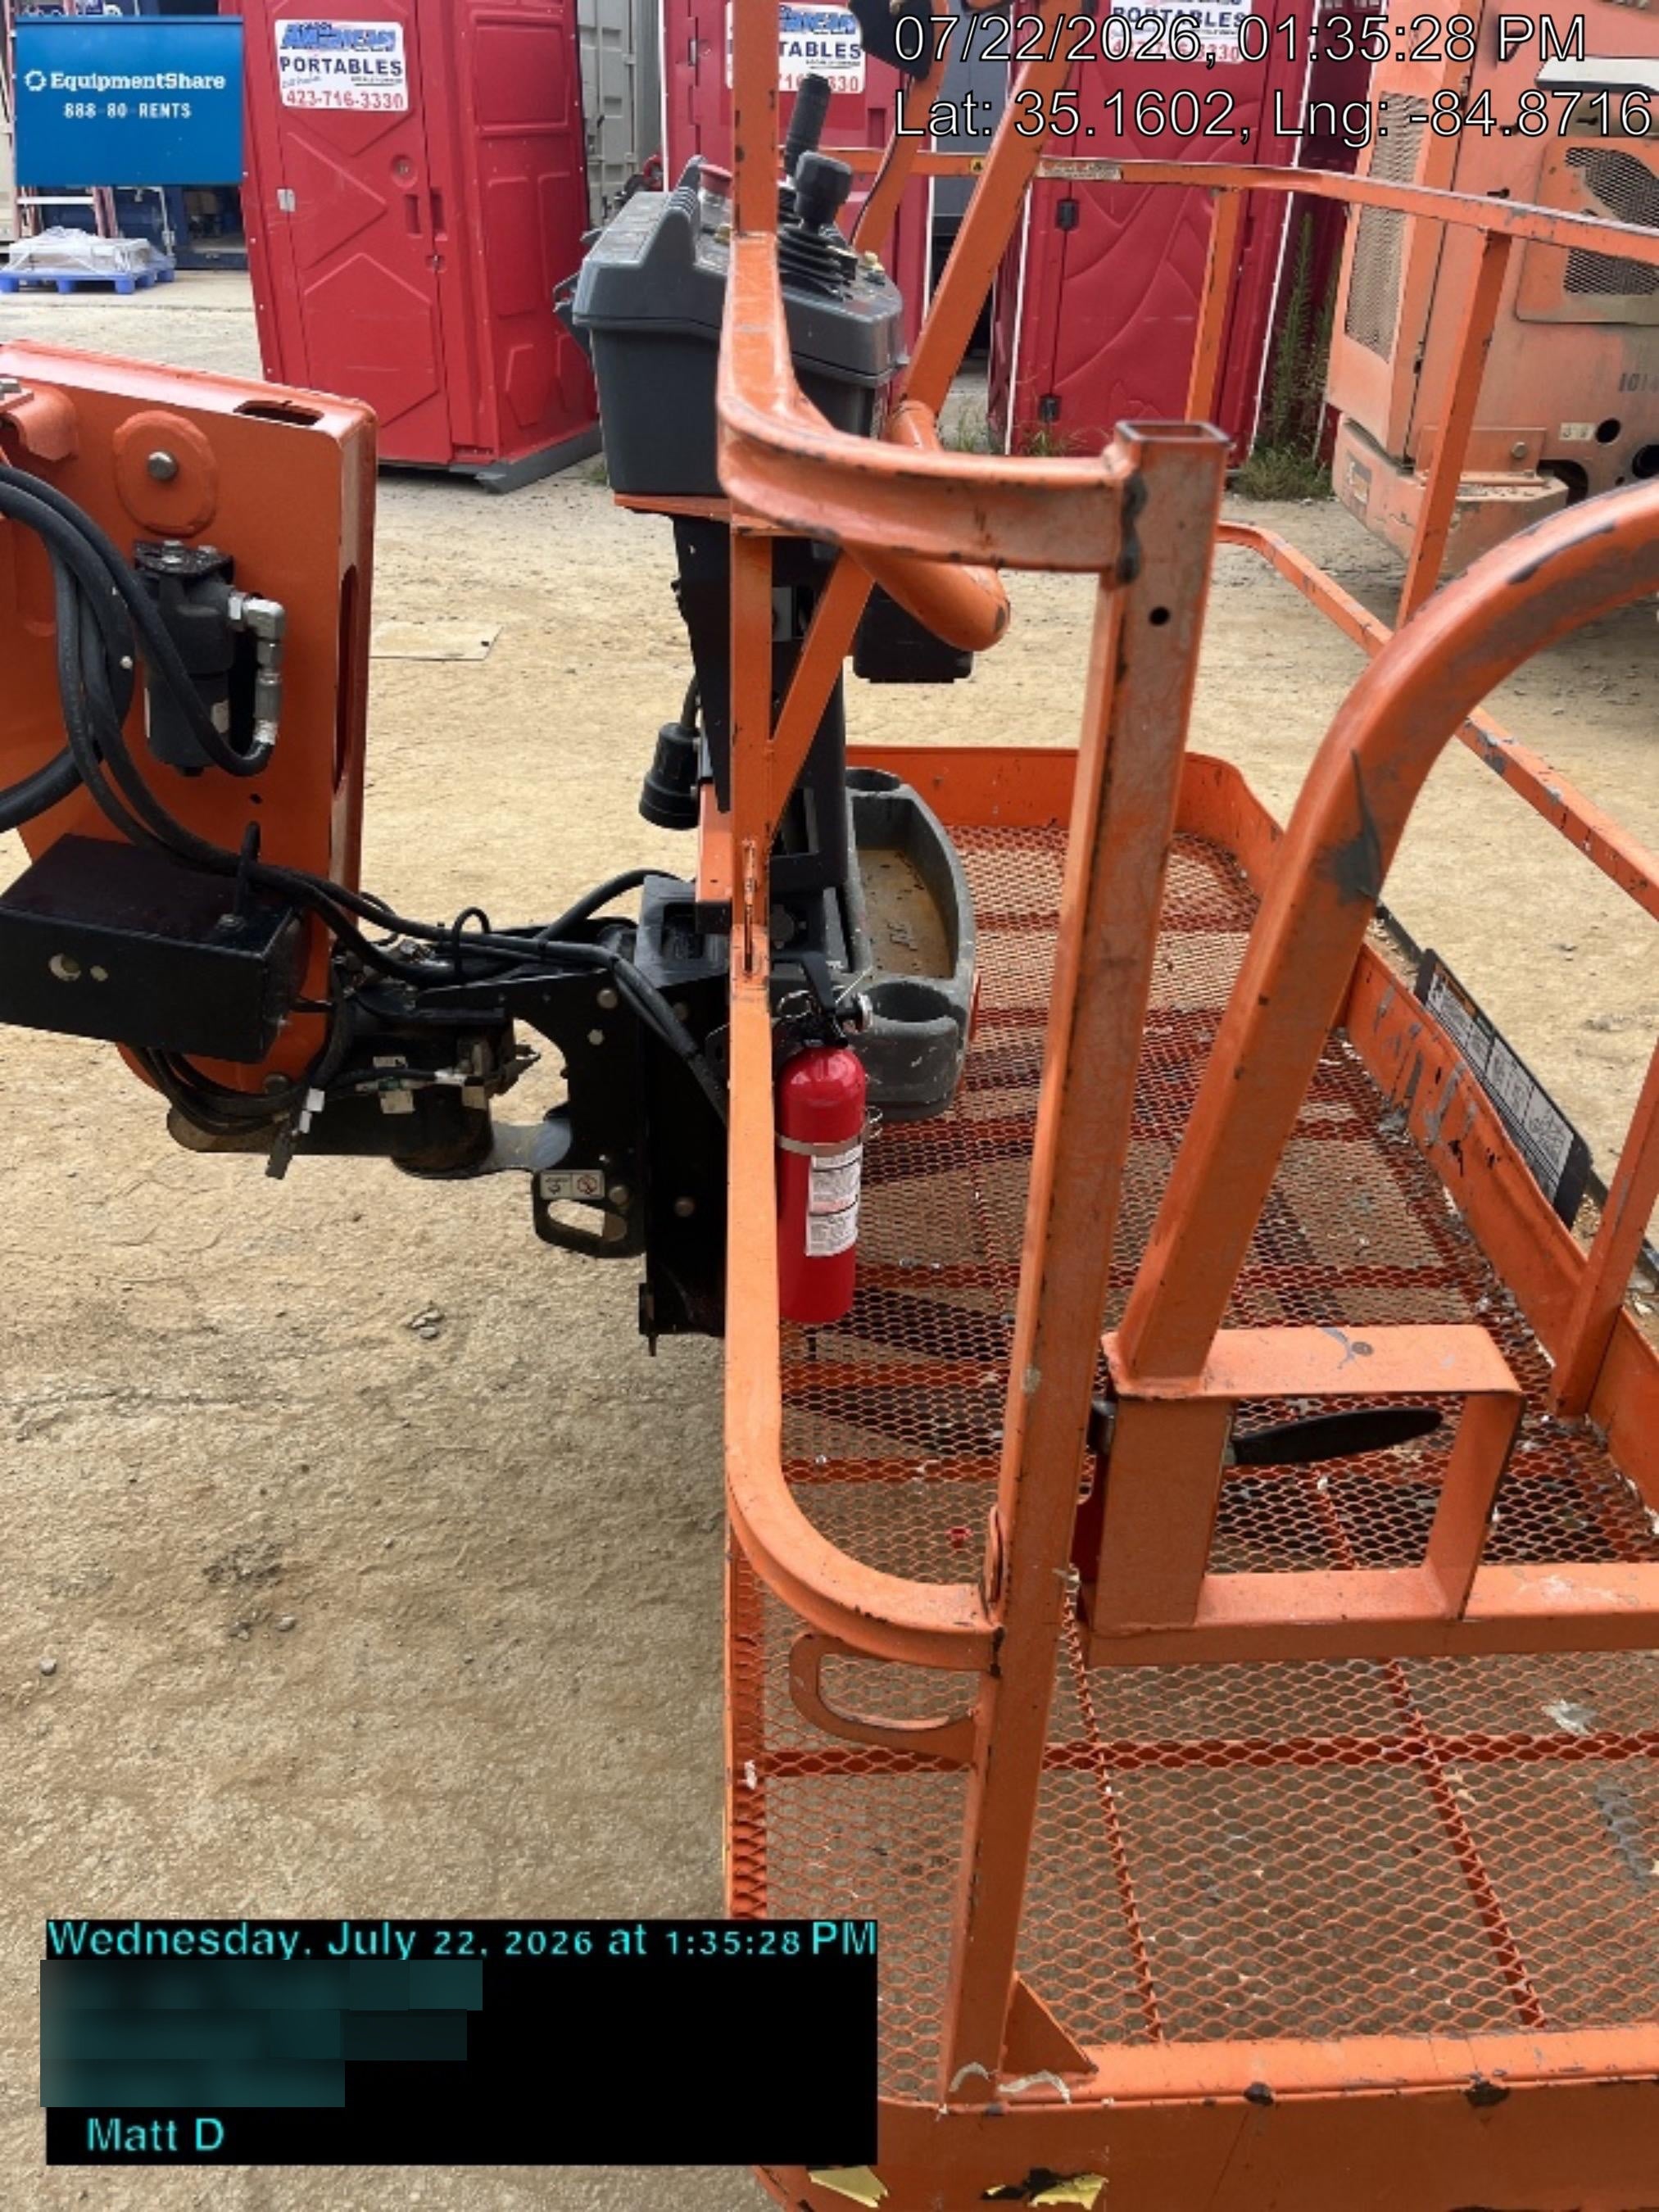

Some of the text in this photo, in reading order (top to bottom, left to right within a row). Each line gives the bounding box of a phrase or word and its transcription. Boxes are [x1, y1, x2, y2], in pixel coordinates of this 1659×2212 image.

[279, 56, 403, 76] PORTABLES
[50, 70, 226, 92] EquipmentShare
[287, 90, 404, 108] 423-716-3330
